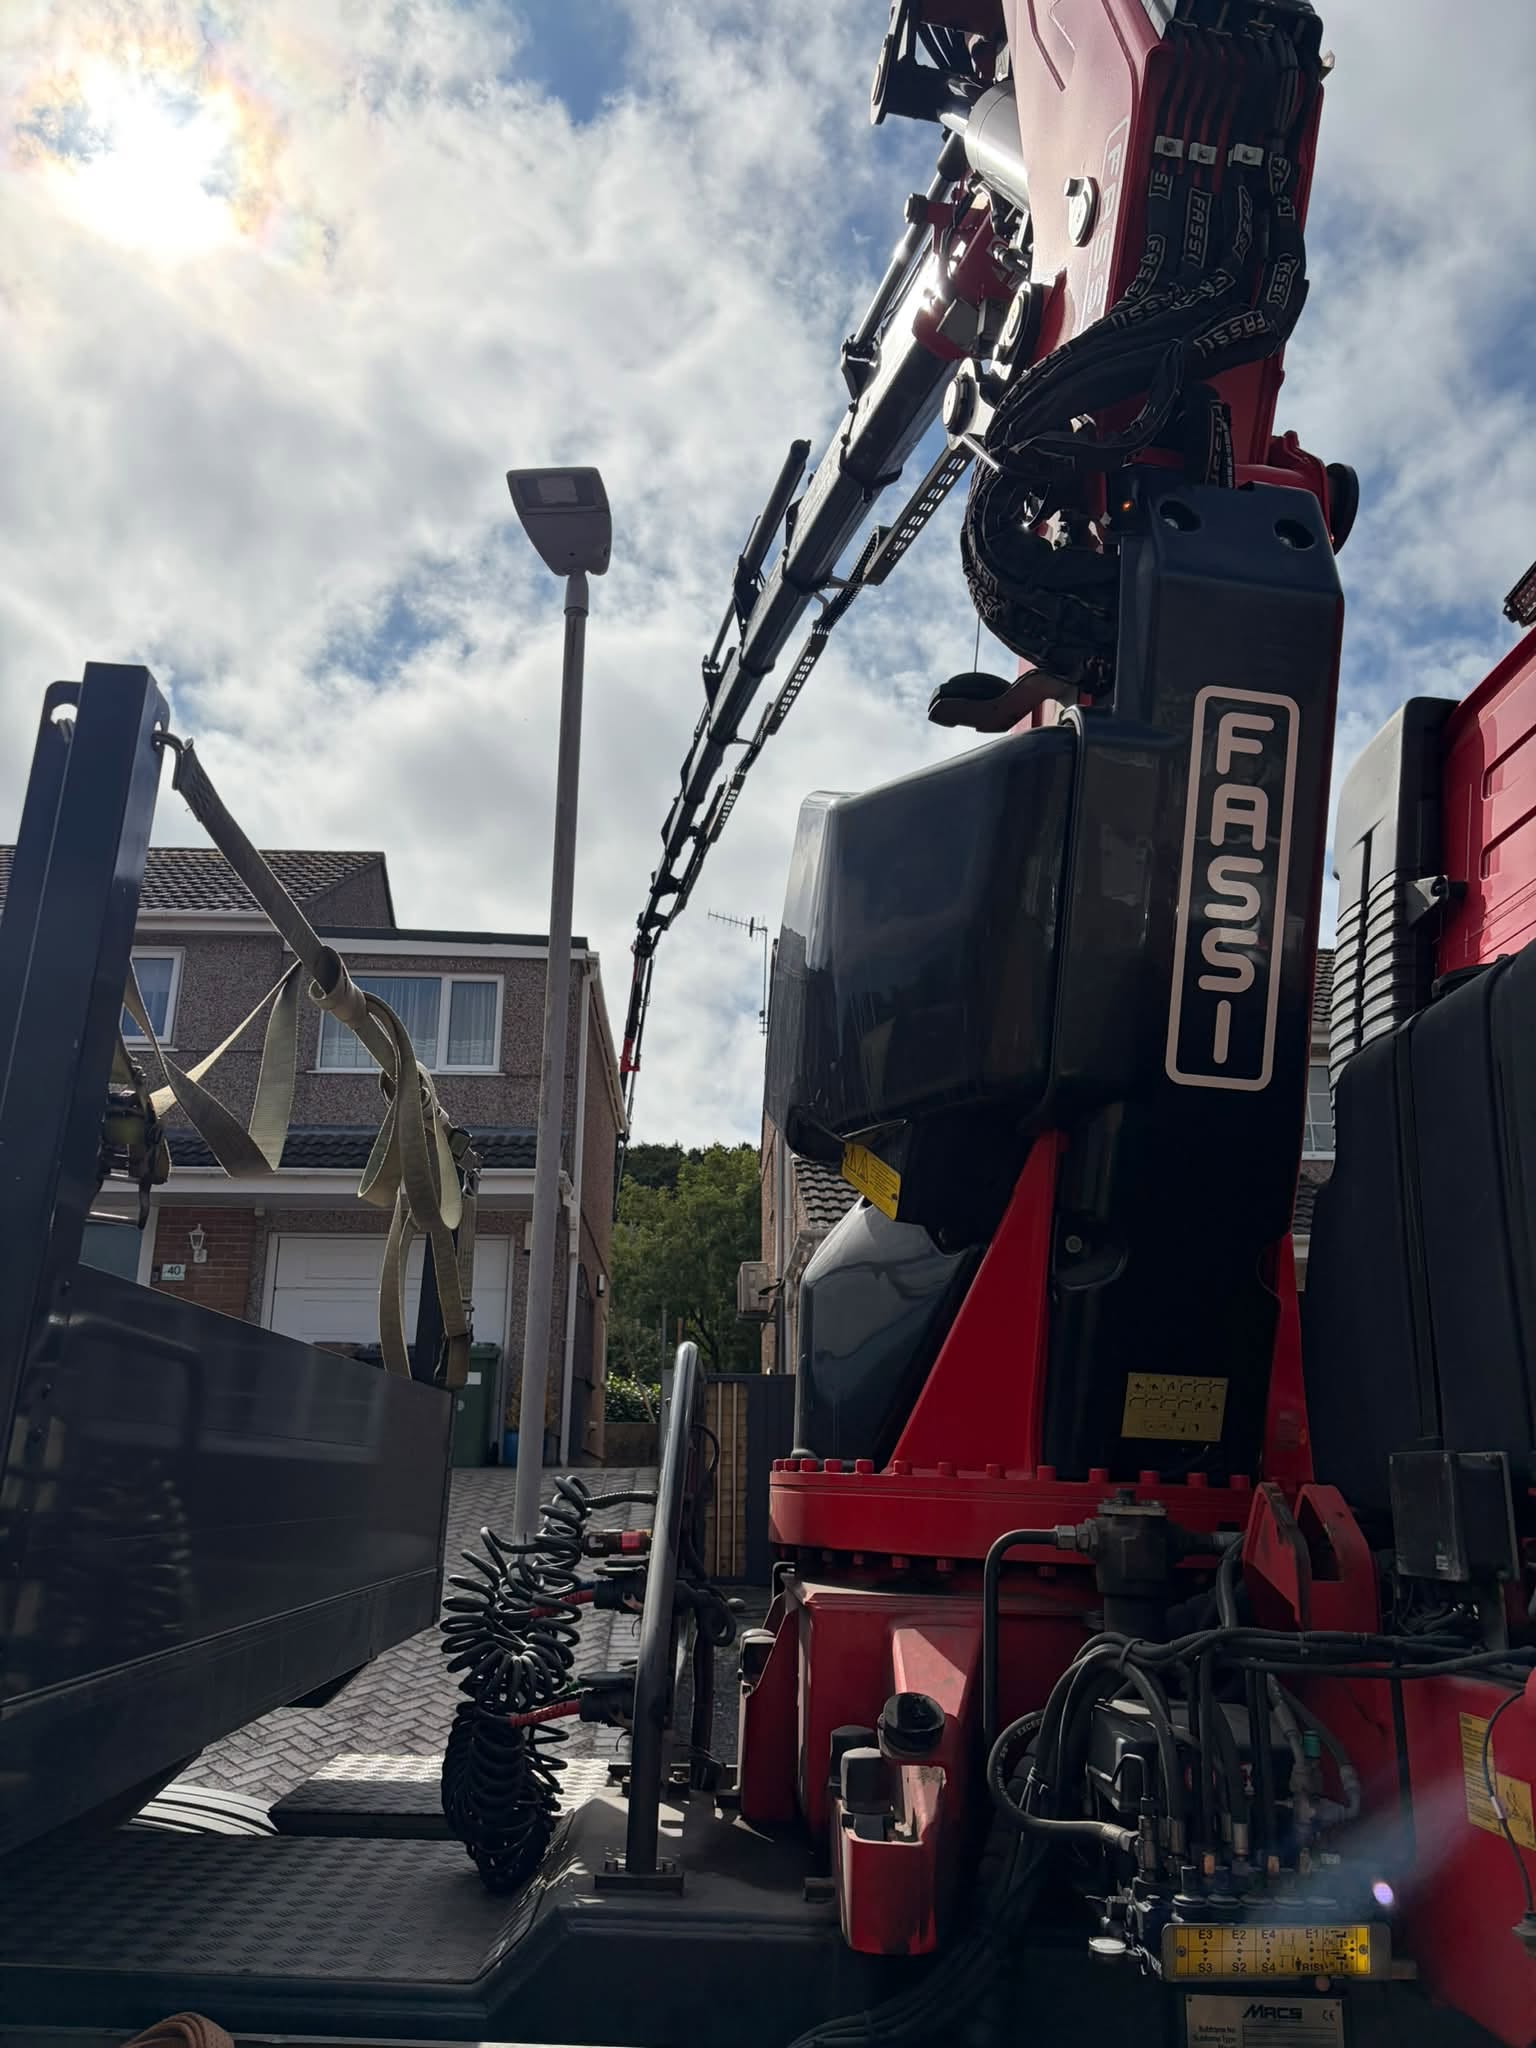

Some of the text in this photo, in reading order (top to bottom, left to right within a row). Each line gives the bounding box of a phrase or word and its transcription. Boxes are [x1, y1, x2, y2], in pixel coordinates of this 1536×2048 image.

[1087, 143, 1122, 314] FASS
[1187, 195, 1207, 265] FASSI
[1203, 313, 1267, 350] FASSI
[1198, 711, 1275, 1065] FASSI
[167, 1265, 181, 1275] 40
[1199, 1928, 1319, 1940] E3 E2 E4 E1
[1198, 1962, 1213, 1973] S3
[1232, 1962, 1247, 1973] S2
[1261, 1962, 1276, 1973] S4
[1242, 2004, 1303, 2020] MACS
